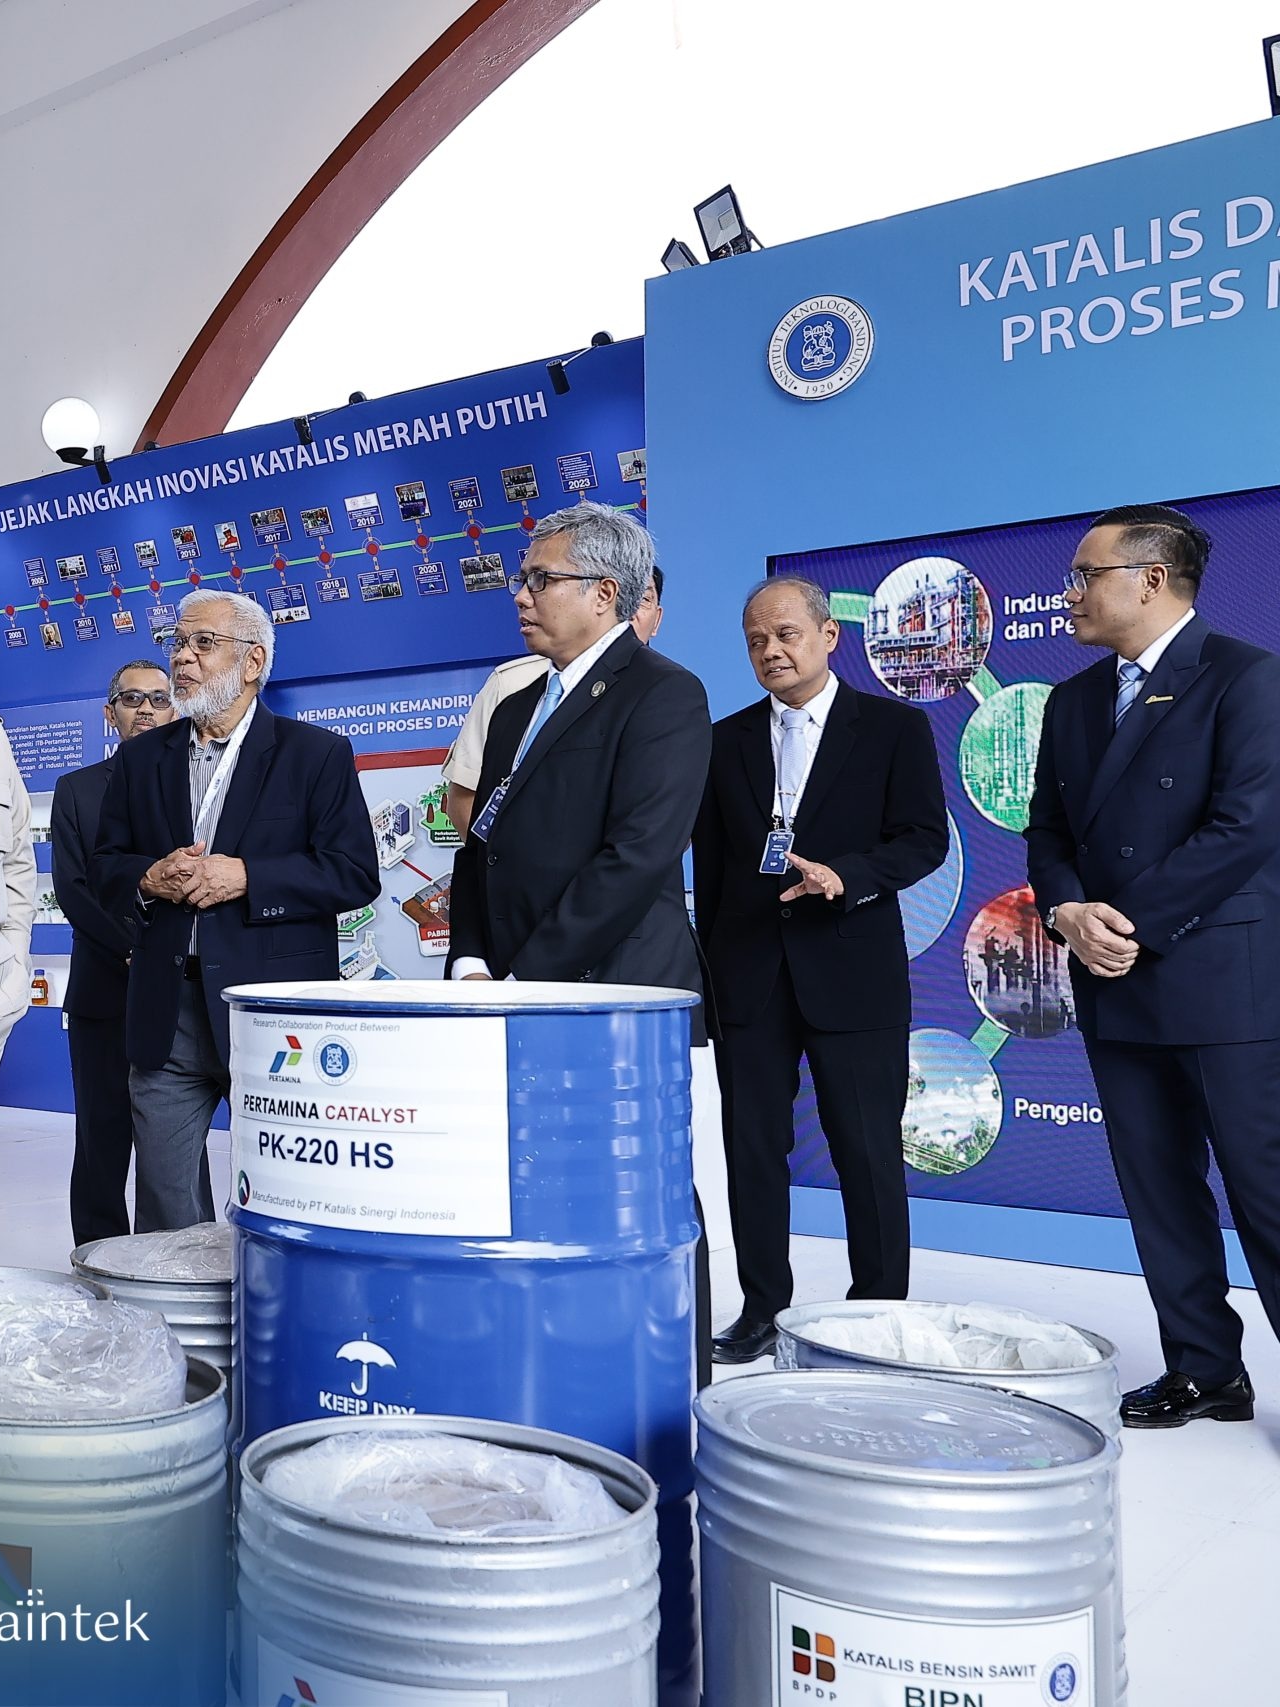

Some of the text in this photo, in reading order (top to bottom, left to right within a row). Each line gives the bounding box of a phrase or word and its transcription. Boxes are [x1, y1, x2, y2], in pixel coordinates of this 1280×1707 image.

[959, 208, 1204, 307] KATALIS
[1225, 195, 1280, 248] D
[1002, 269, 1245, 362] PROSES
[772, 300, 866, 389] INSTITUT TEKNOLOGI BANDUNG
[805, 382, 833, 394] 1920
[0, 391, 548, 533] JEJAK LANGKAH INOVASI KATALIS MERAH PUTIH
[568, 478, 591, 489] 2023
[458, 499, 477, 509] 2021
[356, 516, 375, 527] 2019
[264, 532, 281, 543] 2017
[180, 548, 196, 558] 2015
[102, 563, 118, 573] 2011
[419, 565, 437, 574] 2020
[322, 579, 339, 590] 2018
[152, 607, 168, 616] 2014
[77, 618, 92, 627] 2010
[1004, 616, 1075, 641] dan Pe
[296, 694, 474, 723] MEMBANGUN KEMANDIRI
[377, 717, 433, 733] PROSES
[252, 1018, 400, 1032] Research Collaboration Product Between
[268, 1074, 301, 1084] PERTAMINA
[243, 1094, 418, 1123] PERTAMINA CATALYST
[1014, 1097, 1106, 1126] Pengelo
[258, 1131, 394, 1169] PK-220 HS
[252, 1190, 456, 1220] Manufactured by PT Katalis Sinergi Indonesia
[319, 1390, 368, 1415] KEEP
[843, 1647, 1037, 1679] KATALIS BENSIN SAWIT
[792, 1680, 837, 1701] BPDP
